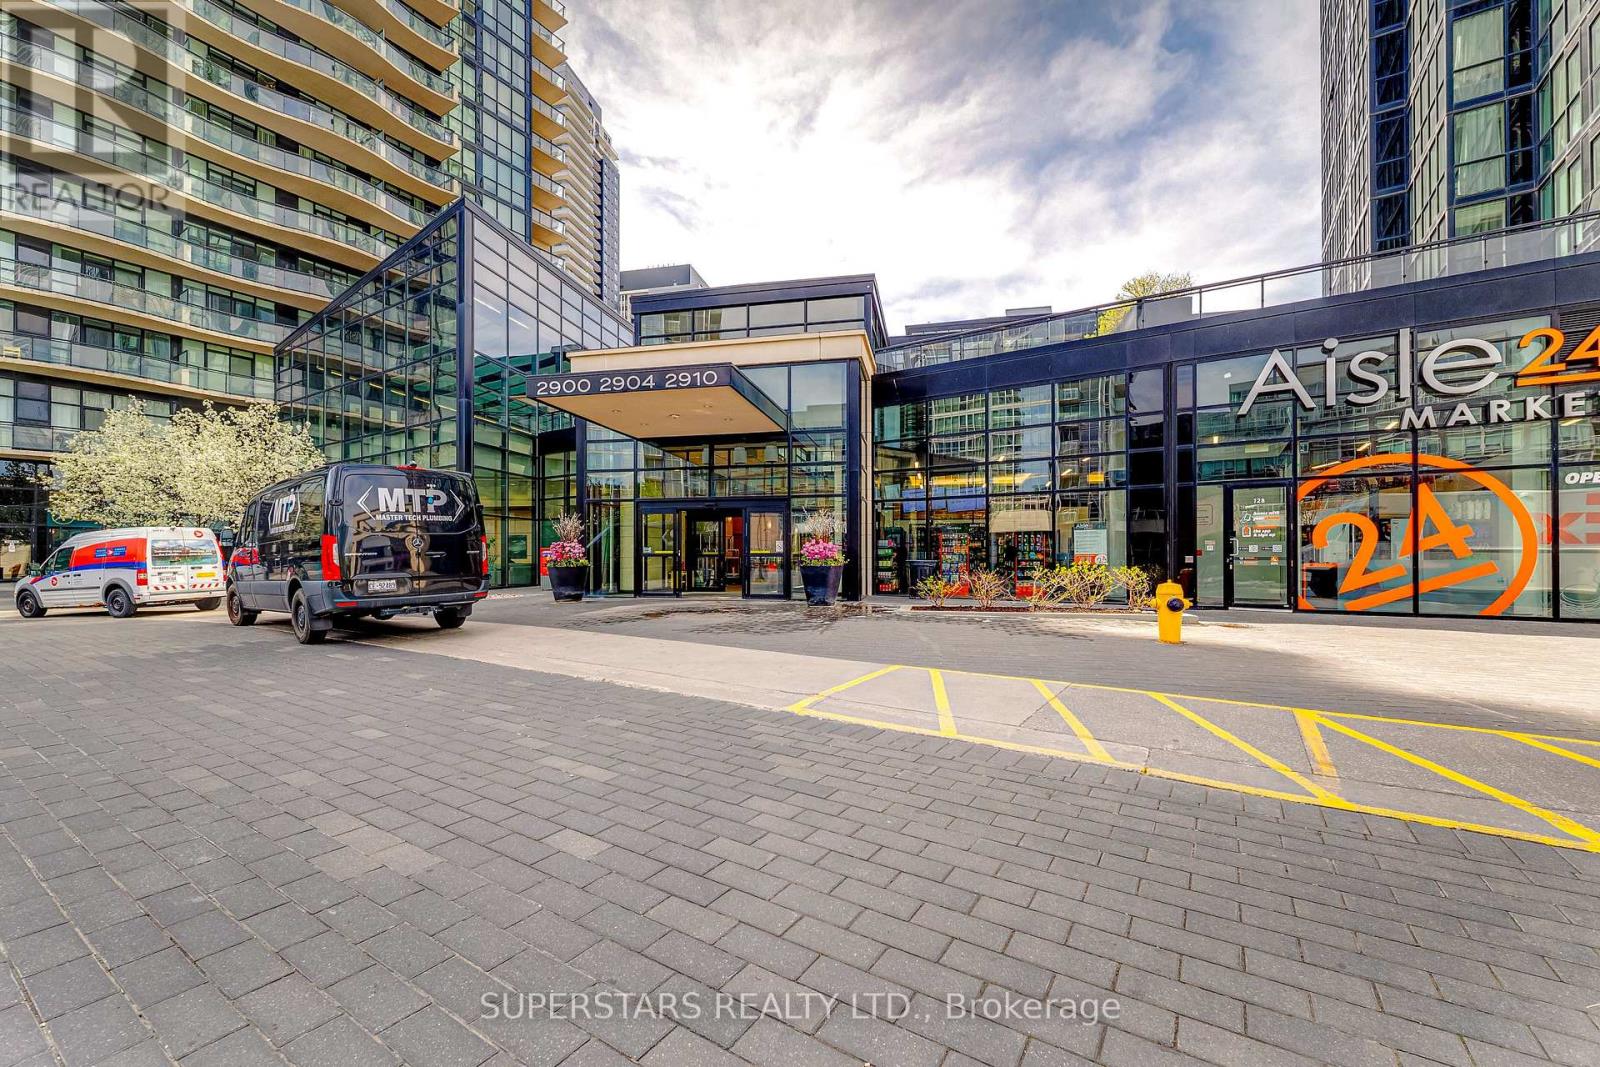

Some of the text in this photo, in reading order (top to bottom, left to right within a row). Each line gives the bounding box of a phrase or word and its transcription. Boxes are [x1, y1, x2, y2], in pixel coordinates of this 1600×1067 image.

[536, 370, 718, 395] 2900 2904 2910
[1237, 328, 1503, 416] Aisle
[1400, 391, 1600, 430] MARKE
[272, 493, 296, 526] MTP
[377, 485, 448, 513] MTP
[375, 513, 403, 521] MASTER
[1312, 482, 1476, 595] 24
